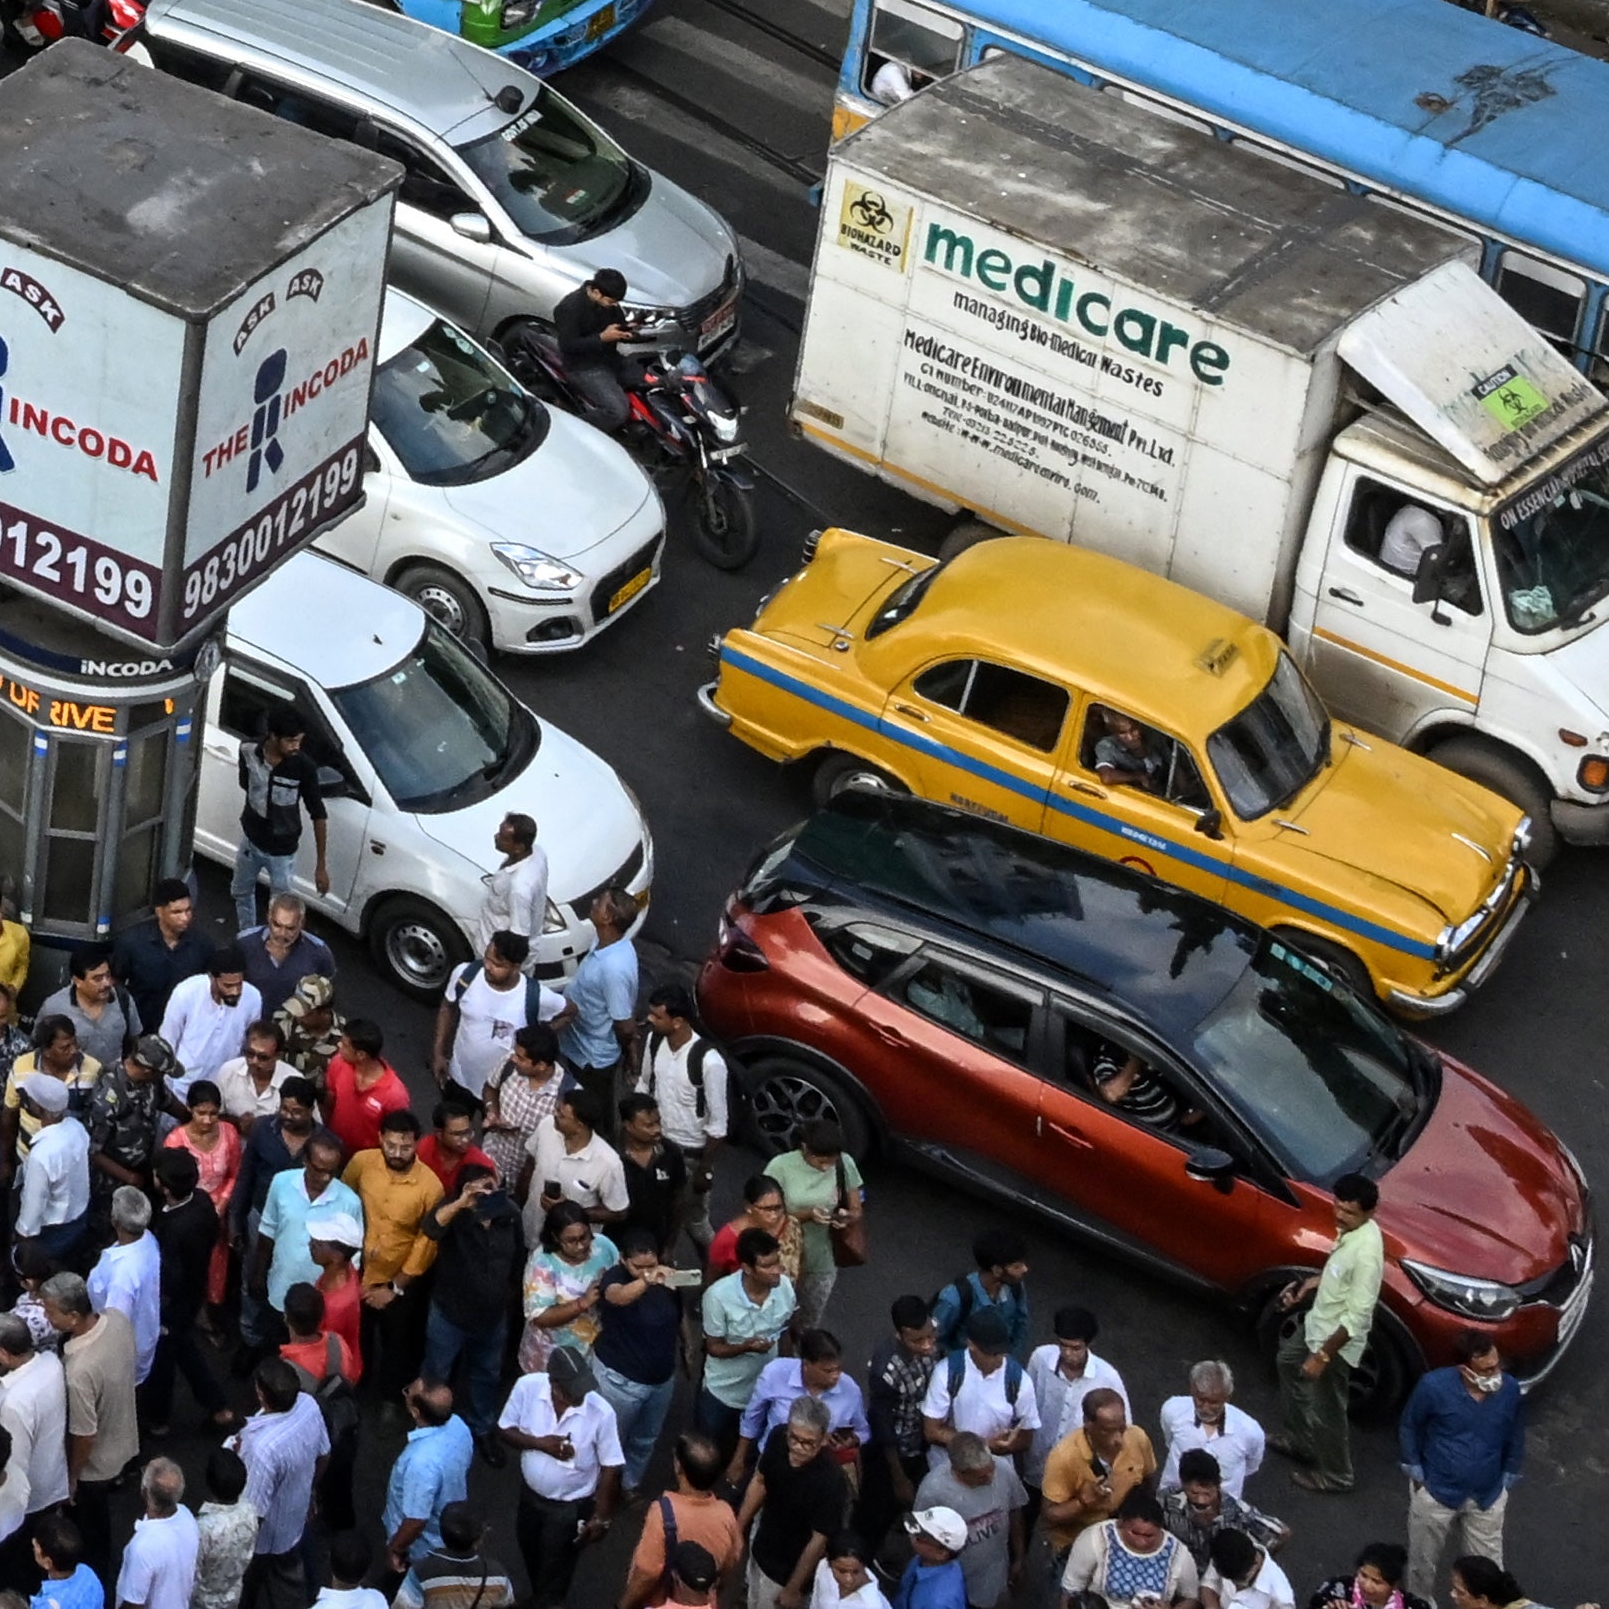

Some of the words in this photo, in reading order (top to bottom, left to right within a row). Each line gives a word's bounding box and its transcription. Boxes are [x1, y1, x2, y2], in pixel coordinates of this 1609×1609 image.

[839, 223, 901, 257] BIOHAZARD
[850, 242, 892, 266] WASTE
[4, 272, 60, 324] ASK
[289, 273, 320, 296] ASK
[924, 223, 1230, 386] medicare
[235, 301, 272, 350] ASK
[953, 290, 1029, 340] managing
[1100, 356, 1164, 398] Wastes
[904, 328, 972, 374] Medicare
[1477, 369, 1512, 396] CAUTION
[202, 423, 250, 479] THE
[283, 337, 369, 420] INCODA
[10, 397, 159, 483] INCODA
[184, 448, 358, 619] 9830012199
